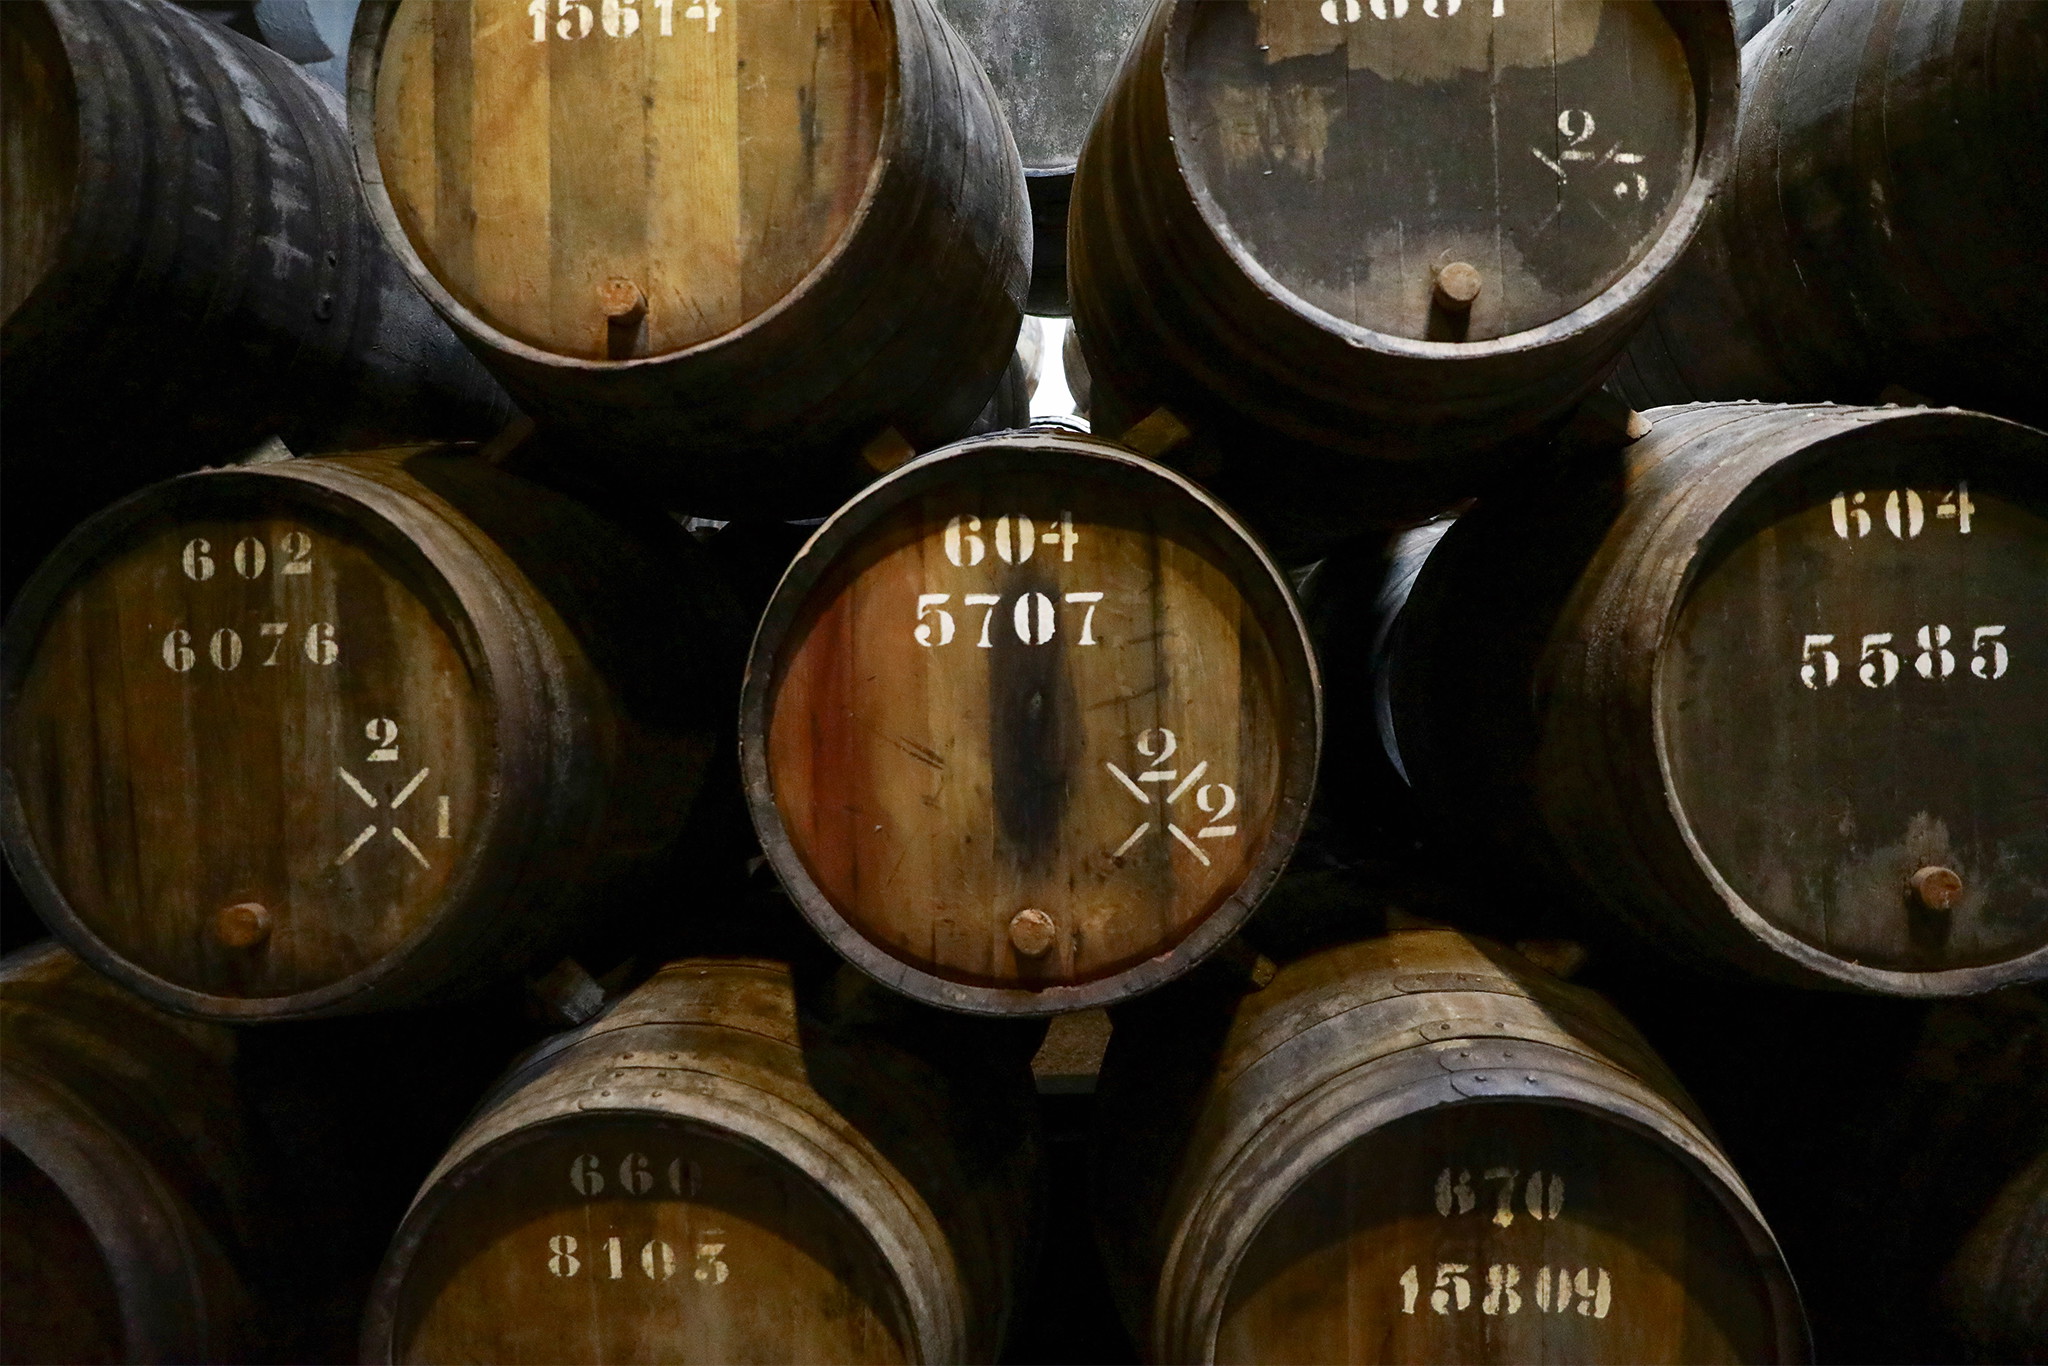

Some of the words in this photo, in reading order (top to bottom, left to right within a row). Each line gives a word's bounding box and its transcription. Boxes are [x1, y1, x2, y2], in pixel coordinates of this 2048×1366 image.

[1830, 480, 1975, 540] 604
[182, 531, 313, 581] 602
[944, 510, 1079, 566] 604
[162, 621, 340, 672] 6076
[914, 591, 1104, 648] 5707
[1800, 624, 2009, 690] 5585
[365, 717, 399, 762] 2
[1136, 727, 1178, 782] 2
[1196, 783, 1238, 838] 2
[570, 1153, 703, 1196] 660
[1434, 1166, 1565, 1228] 670
[1399, 1262, 1612, 1319] 15809
